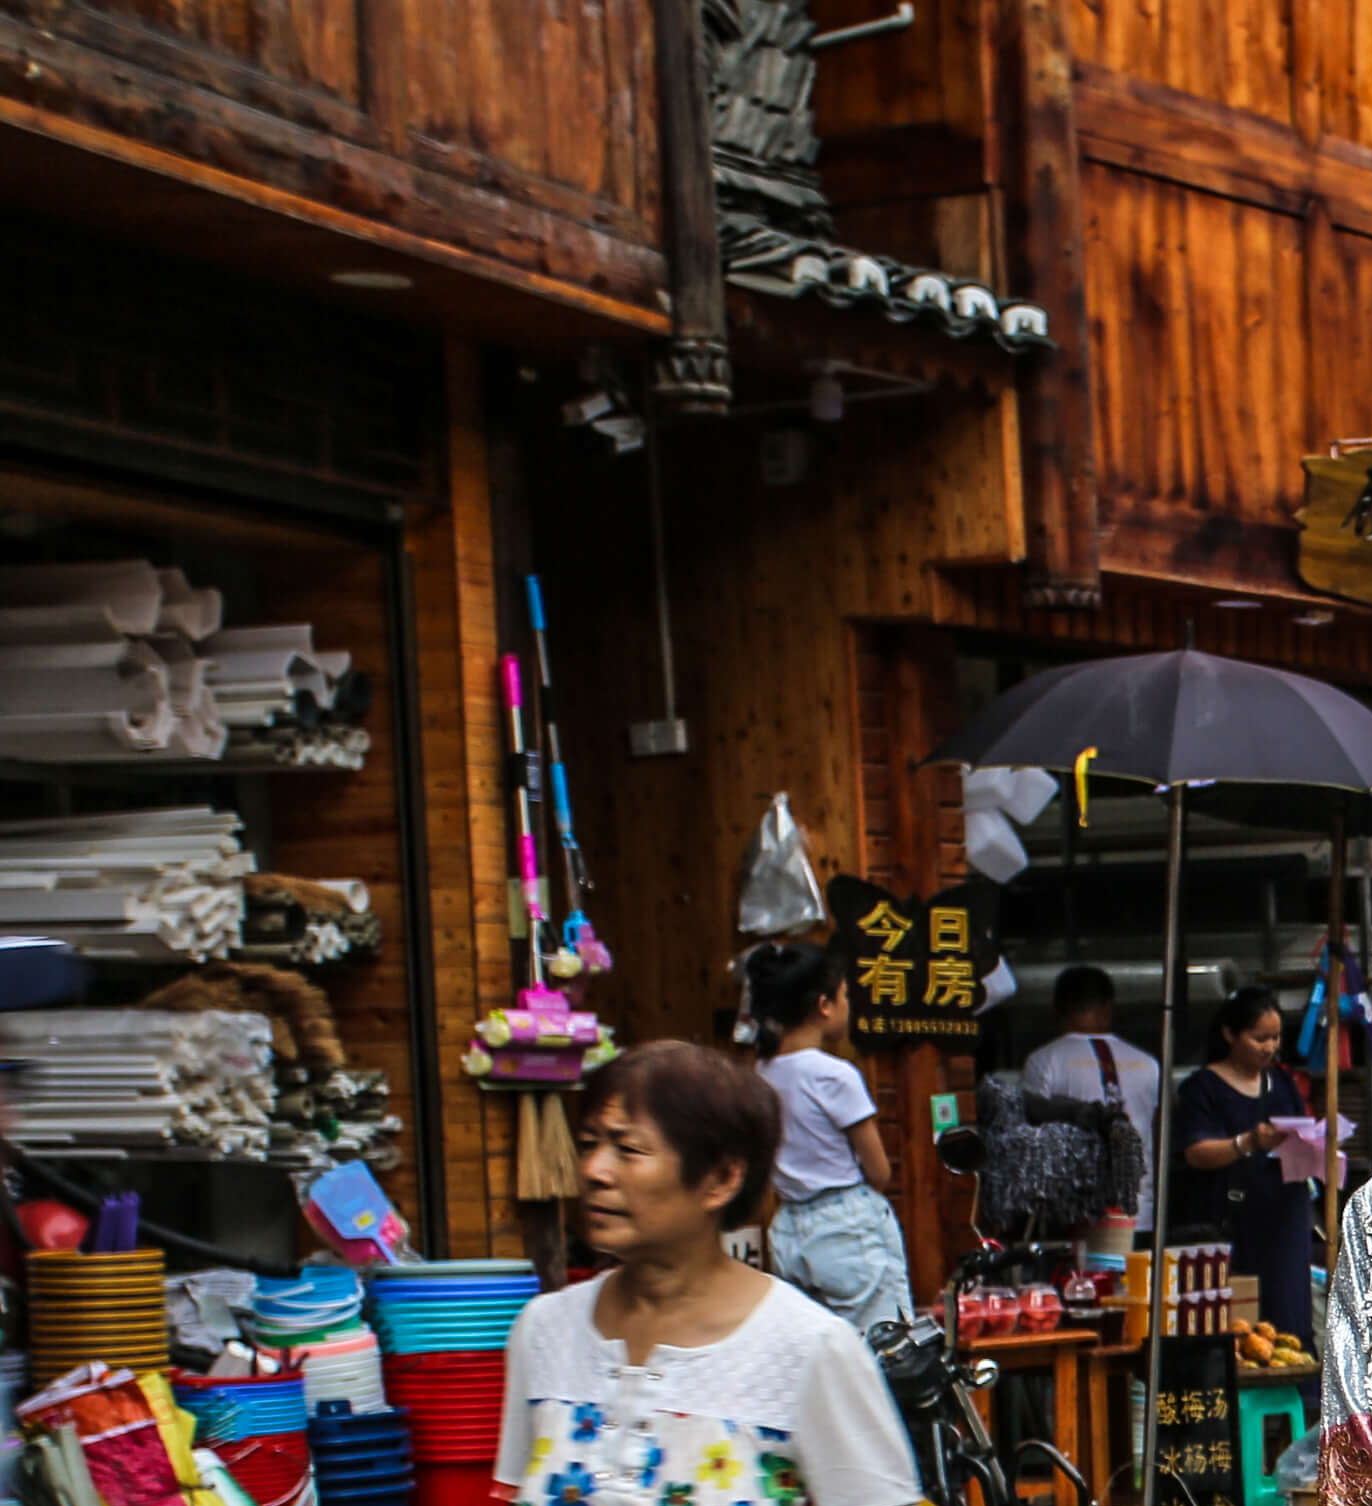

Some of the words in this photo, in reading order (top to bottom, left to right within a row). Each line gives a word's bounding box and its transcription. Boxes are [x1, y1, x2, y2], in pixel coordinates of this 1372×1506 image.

[857, 900, 969, 953] 今日
[856, 954, 976, 1008] 有房
[1156, 1388, 1228, 1424] 酸梅汤
[1159, 1440, 1233, 1474] 冰杨梅
